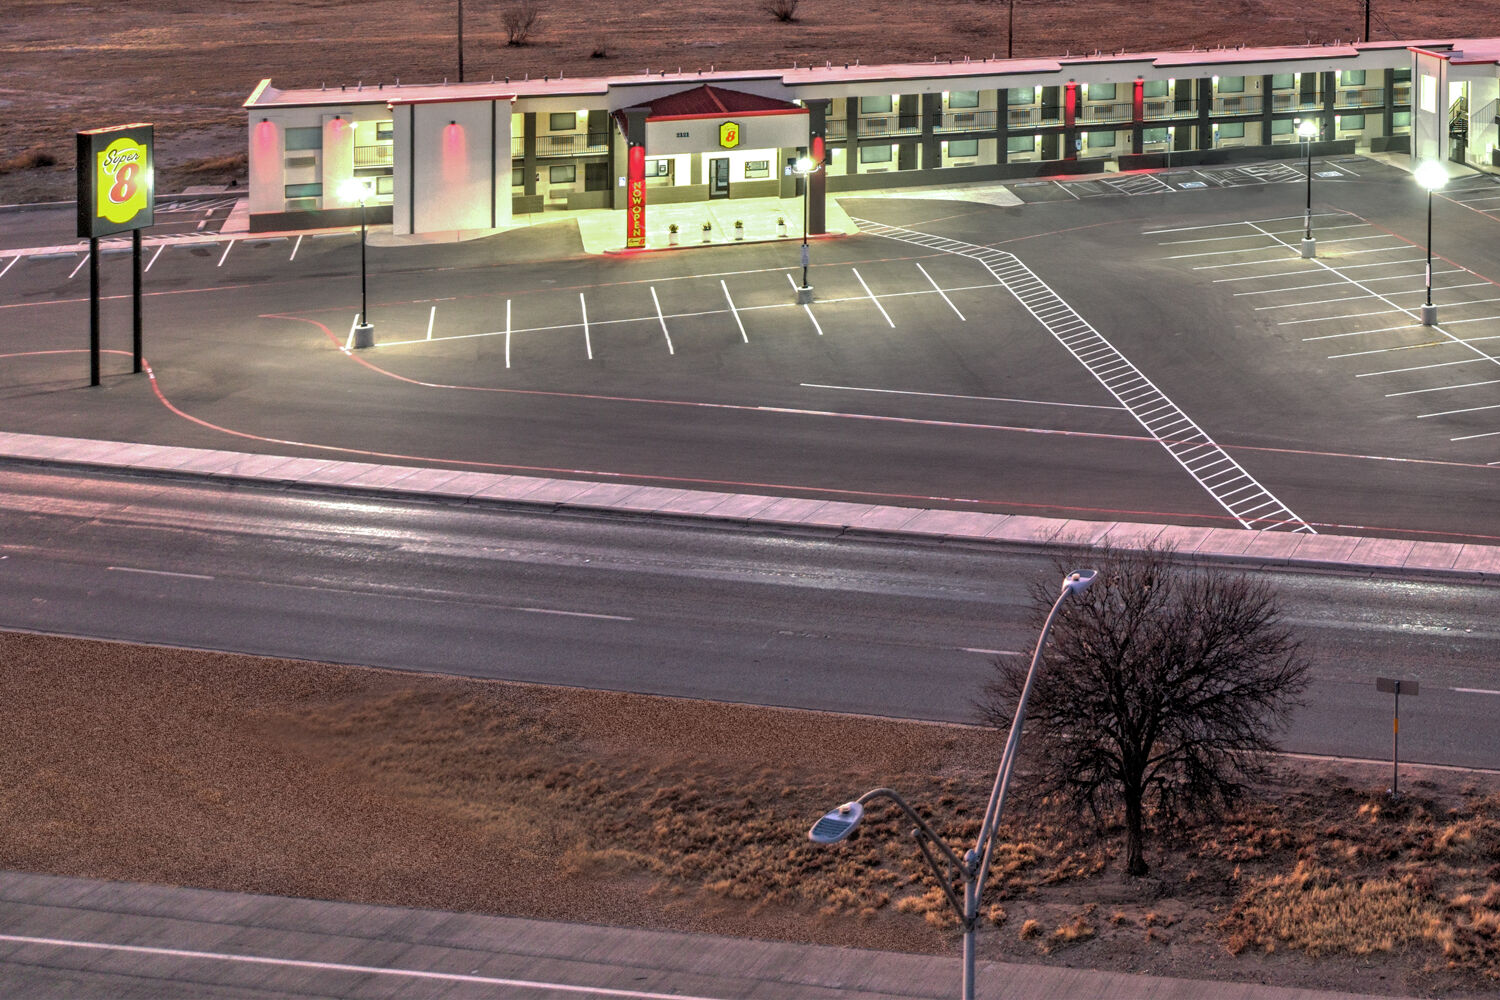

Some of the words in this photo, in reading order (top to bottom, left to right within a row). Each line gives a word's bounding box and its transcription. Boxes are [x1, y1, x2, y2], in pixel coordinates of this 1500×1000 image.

[726, 130, 736, 142] 8
[103, 149, 140, 172] Super
[109, 163, 139, 204] 8
[632, 181, 642, 205] NOW
[632, 206, 642, 236] OPEN
